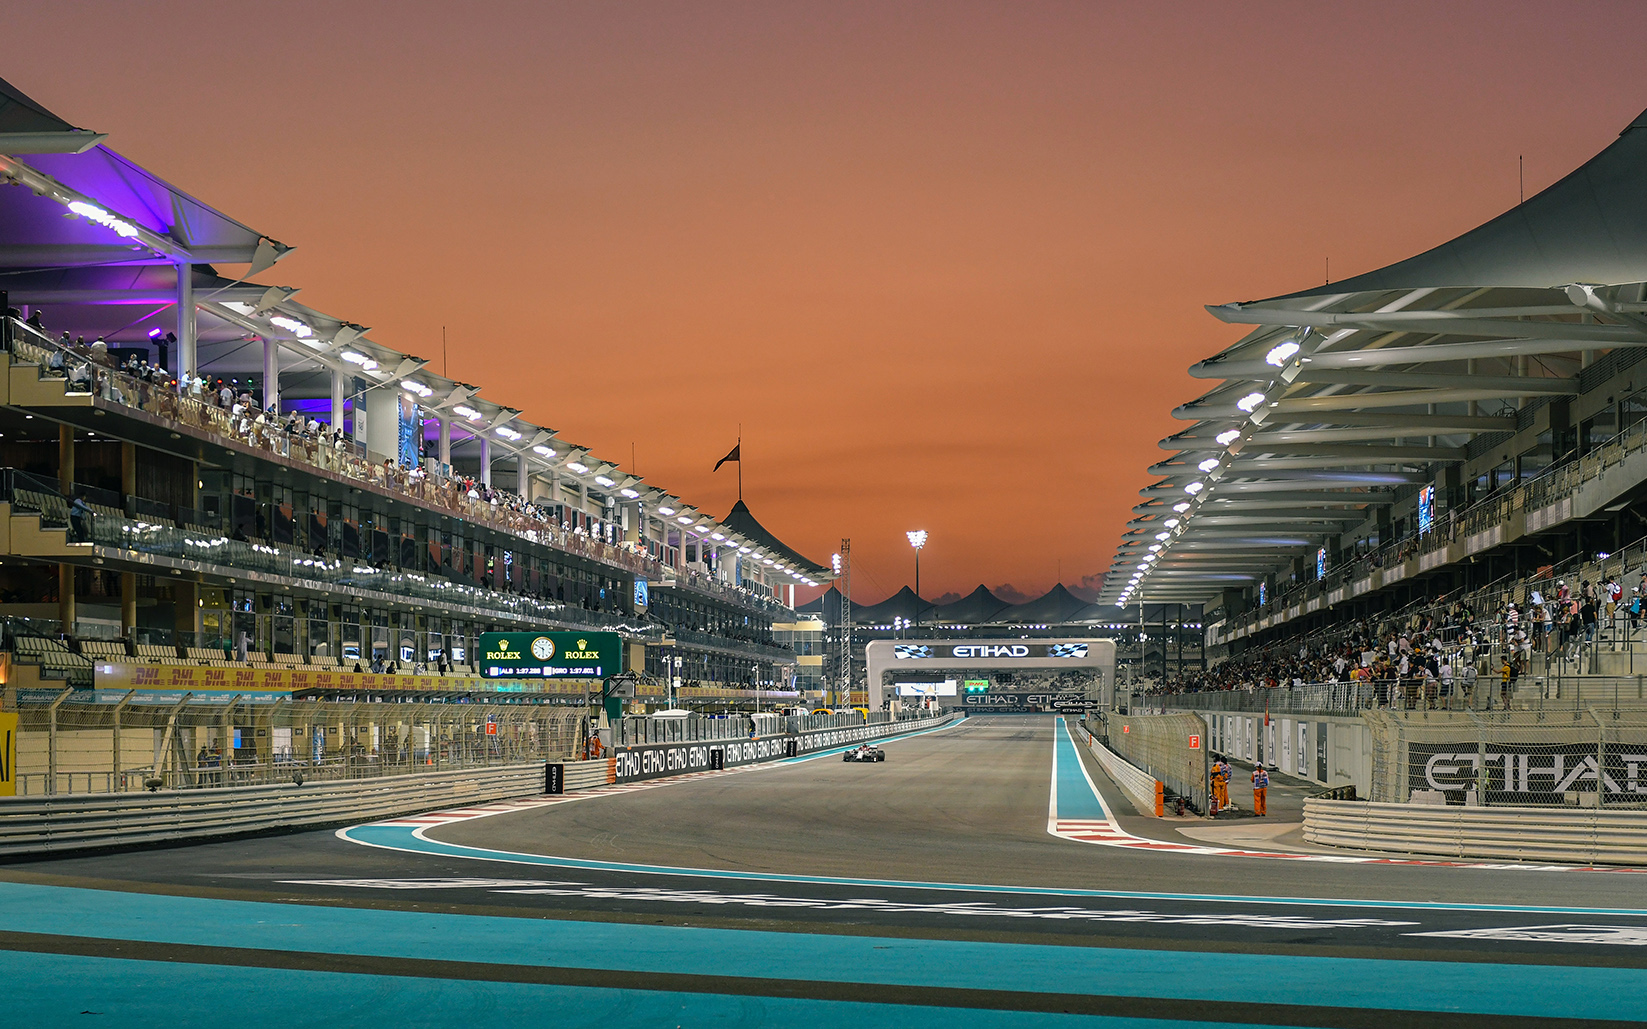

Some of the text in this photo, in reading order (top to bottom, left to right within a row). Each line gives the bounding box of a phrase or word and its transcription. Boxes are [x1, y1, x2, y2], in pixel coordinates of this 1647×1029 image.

[486, 651, 521, 660] ROLEX
[565, 651, 600, 659] ROLEX
[953, 645, 1029, 657] ETIHAD
[135, 667, 161, 686] DHL
[171, 668, 195, 687] DHL
[204, 669, 227, 687] DHL
[235, 670, 256, 688] DHL
[264, 671, 284, 688] DHL
[291, 673, 309, 688] DHL
[966, 695, 1019, 704] ETIHAD
[616, 751, 640, 777] ETIHAD
[642, 749, 665, 774] ETIHAD
[667, 747, 687, 771] ETIHAD
[689, 746, 707, 768] ETIHAD
